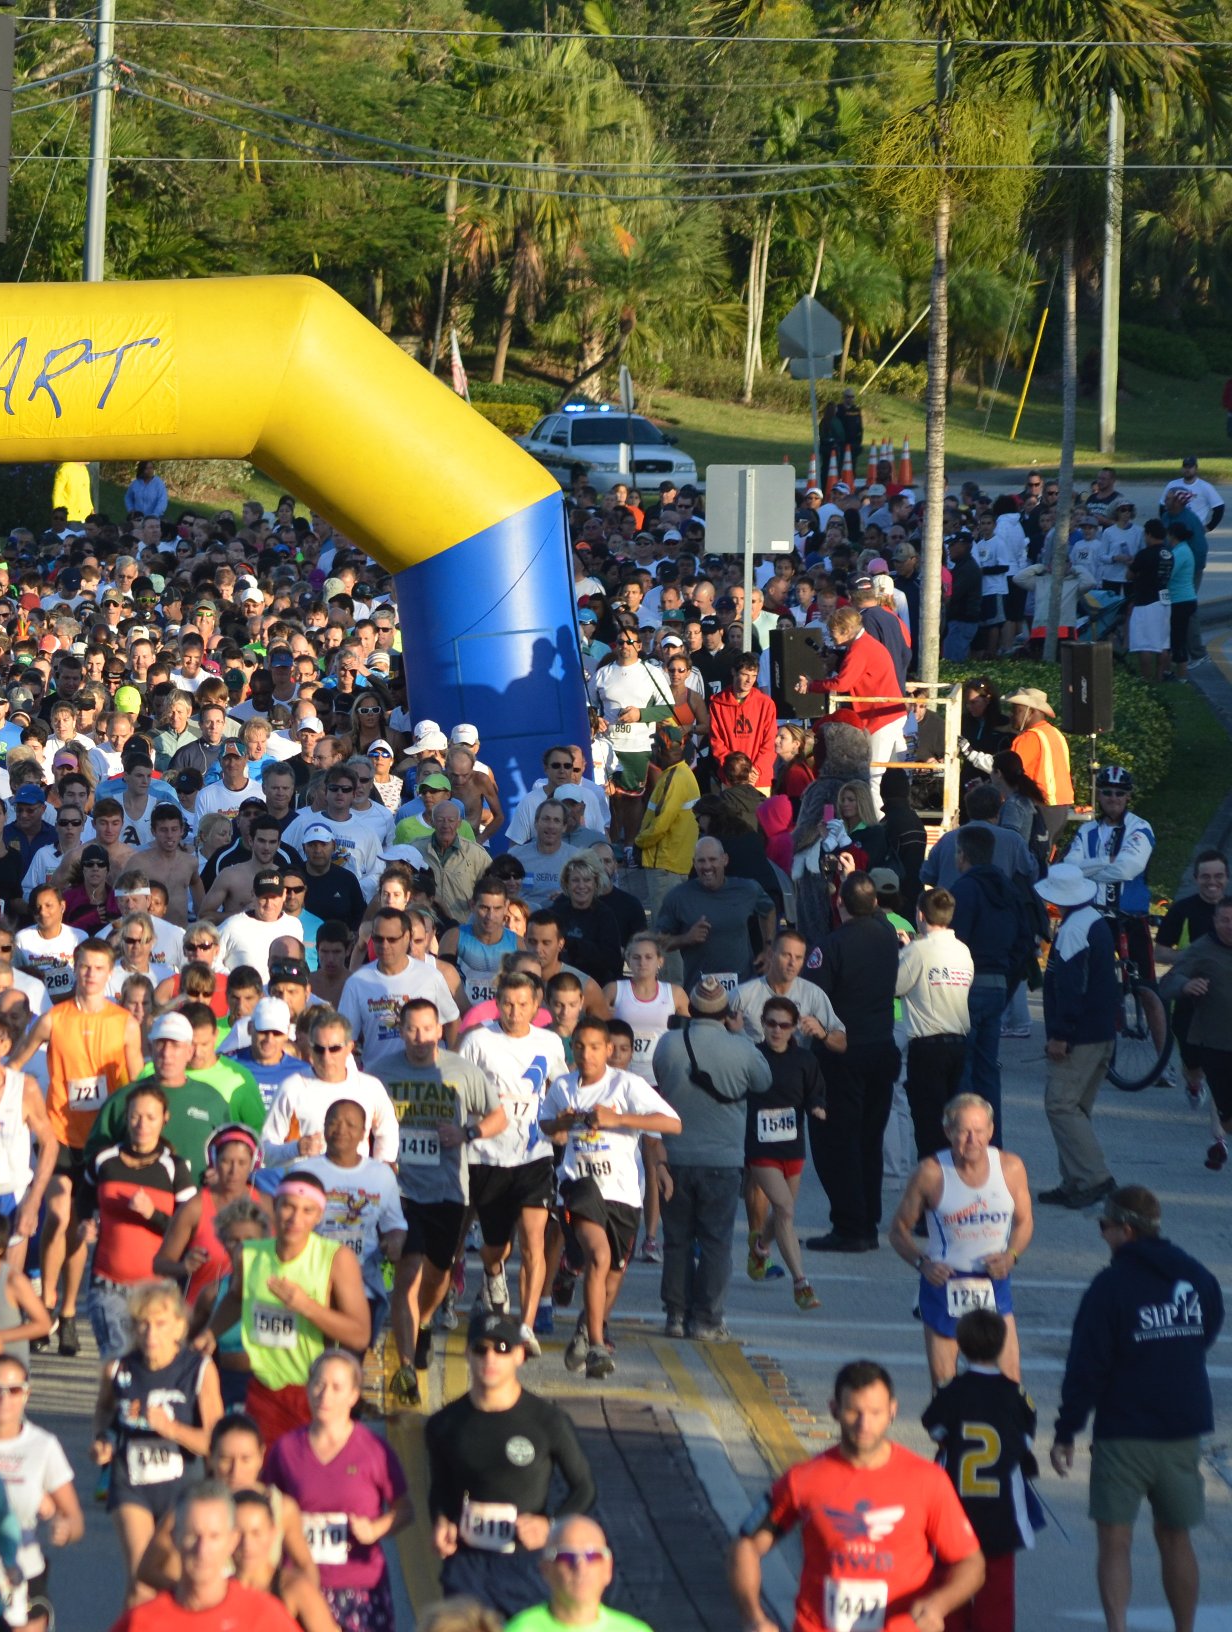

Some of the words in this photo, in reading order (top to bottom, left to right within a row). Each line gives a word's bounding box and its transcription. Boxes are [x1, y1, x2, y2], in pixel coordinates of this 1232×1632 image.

[615, 724, 632, 734] 890
[536, 873, 558, 882] SERVE
[46, 973, 70, 989] 266
[74, 1085, 100, 1102] 721
[388, 1081, 457, 1100] TITAN
[760, 1115, 795, 1133] 1545
[401, 1138, 438, 1156] 1415
[958, 1212, 1009, 1225] DEPOT
[960, 1421, 1002, 1498] 2
